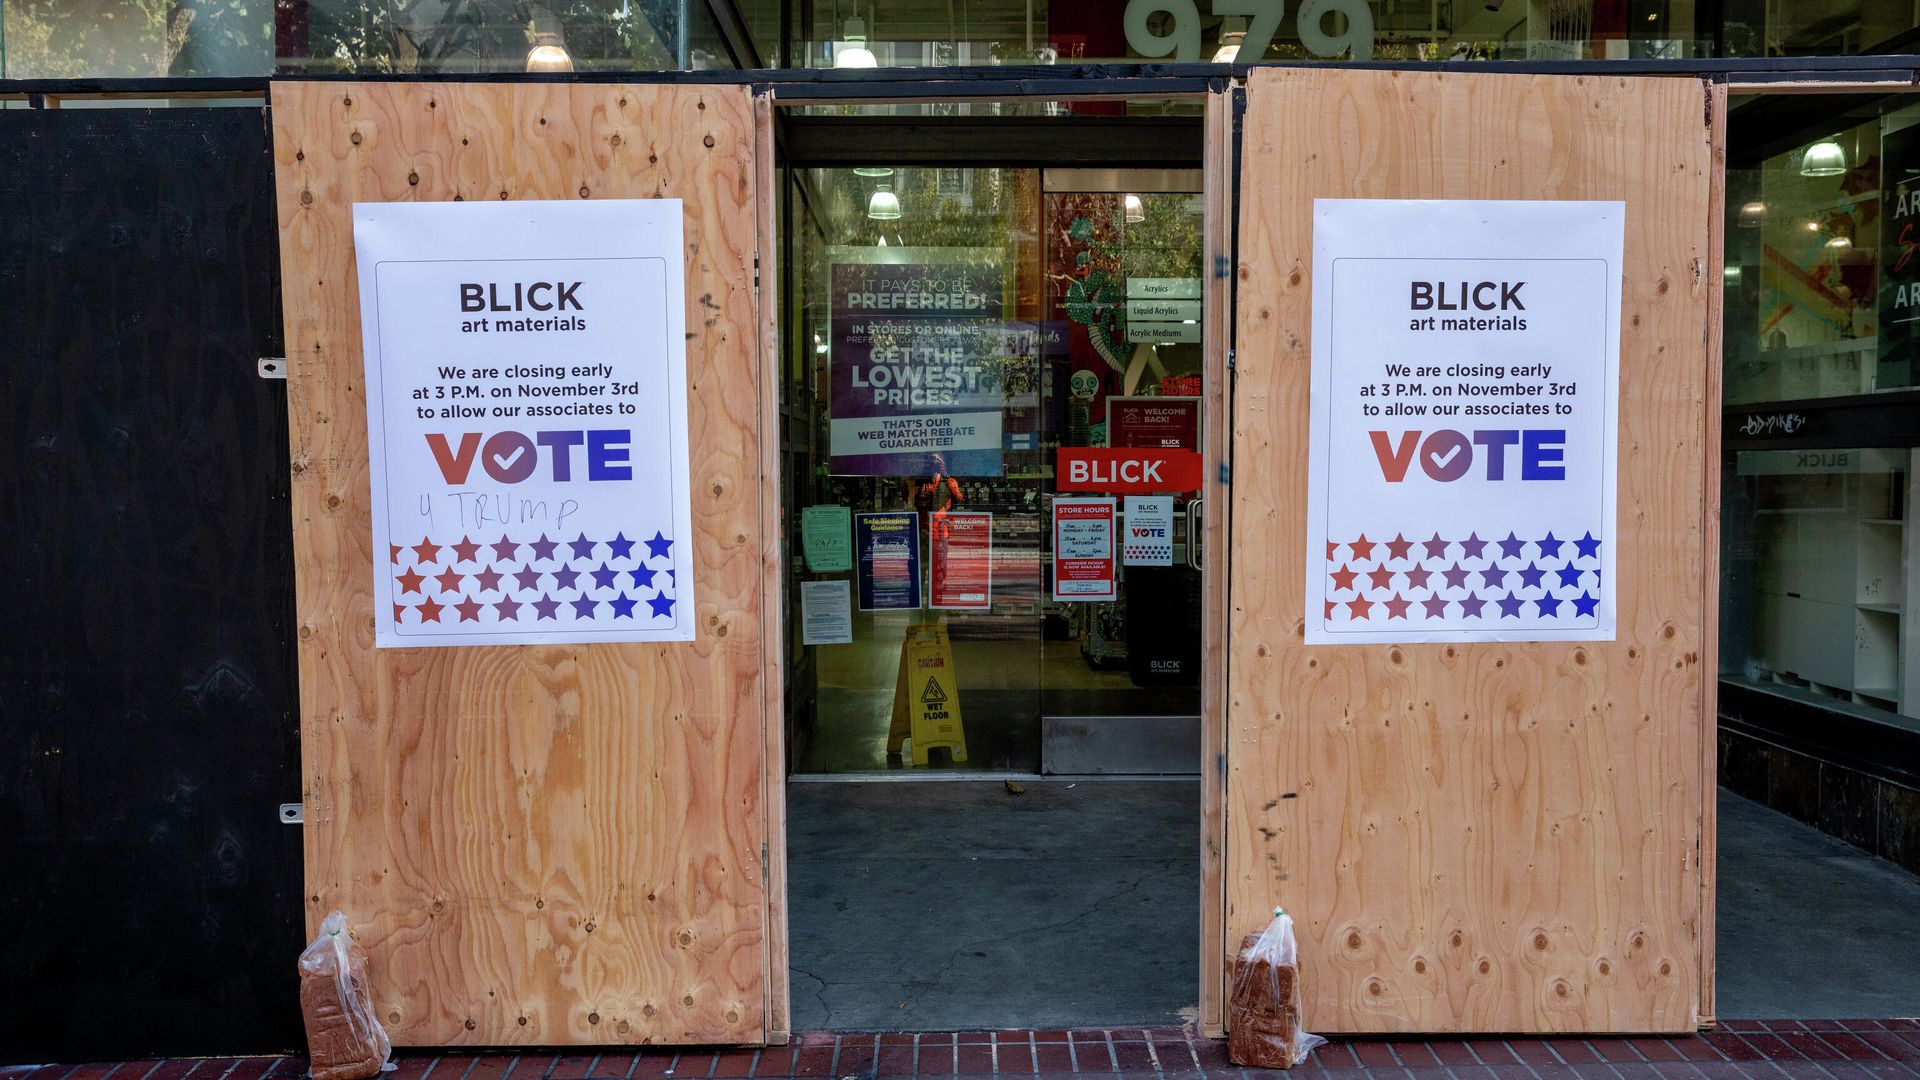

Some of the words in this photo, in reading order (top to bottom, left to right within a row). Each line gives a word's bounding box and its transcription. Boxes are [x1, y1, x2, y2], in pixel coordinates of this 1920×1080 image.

[1123, 0, 1374, 63] 979
[862, 279, 876, 291] IT
[881, 279, 920, 291] PAYS
[922, 279, 946, 292] TO
[953, 279, 972, 291] BE
[1144, 284, 1168, 293] Acrylics
[460, 281, 584, 313] BLICK
[847, 292, 987, 309] PREFERRED!
[1410, 281, 1526, 311] BLICK
[1133, 307, 1154, 316] Liquid
[1155, 307, 1179, 316] Acrylics
[461, 318, 489, 333] art
[495, 315, 586, 332] materials
[852, 325, 864, 334] IN
[867, 325, 912, 334] STORES
[915, 325, 933, 334] OR
[1409, 316, 1436, 331] art
[1441, 315, 1527, 331] materials
[1130, 329, 1151, 338] Acrylic
[1153, 329, 1182, 338] Mediums
[870, 347, 914, 364] GET
[920, 347, 964, 364] THE
[437, 366, 466, 380] We
[471, 368, 499, 379] are
[504, 364, 566, 381] closing
[571, 362, 613, 380] early
[852, 365, 982, 388] LOWEST
[1385, 364, 1411, 377] We
[1416, 366, 1442, 377] are
[1446, 363, 1505, 381] closing
[1510, 363, 1552, 380] early
[1162, 377, 1201, 387] STORE
[1359, 384, 1376, 397] at
[1381, 383, 1391, 397] 3
[1396, 383, 1427, 397] P.M.
[1432, 385, 1452, 397] on
[1458, 382, 1544, 396] November
[1548, 382, 1576, 396] 3rd
[412, 386, 430, 400] at
[435, 386, 445, 399] 3
[451, 385, 485, 399] P.M.
[490, 387, 512, 398] on
[518, 382, 606, 398] November
[611, 381, 639, 396] 3rd
[416, 406, 435, 419] to
[440, 404, 487, 419] allow
[492, 406, 521, 418] our
[526, 402, 613, 417] associates
[618, 402, 636, 415] to
[1144, 408, 1187, 416] WELCOME
[1362, 403, 1380, 416] to
[1384, 402, 1428, 416] allow
[1432, 405, 1460, 416] our
[1464, 401, 1550, 416] associates
[1555, 402, 1573, 415] to
[882, 419, 922, 429] THAT'S
[926, 418, 951, 428] OUR
[1144, 416, 1170, 424] BACK!
[858, 430, 884, 440] WEB
[887, 429, 928, 439] MATCH
[930, 427, 975, 437] REBATE
[879, 437, 954, 449] GUARANTEE!
[424, 429, 633, 485] VOTE
[1368, 429, 1567, 483] VOTE
[1069, 460, 1164, 483] BLICK
[447, 492, 579, 530] TRUMP
[863, 517, 880, 525] Safe
[1131, 528, 1165, 537] VOTE
[1151, 660, 1180, 668] BLICK
[923, 712, 949, 720] FLOOR
